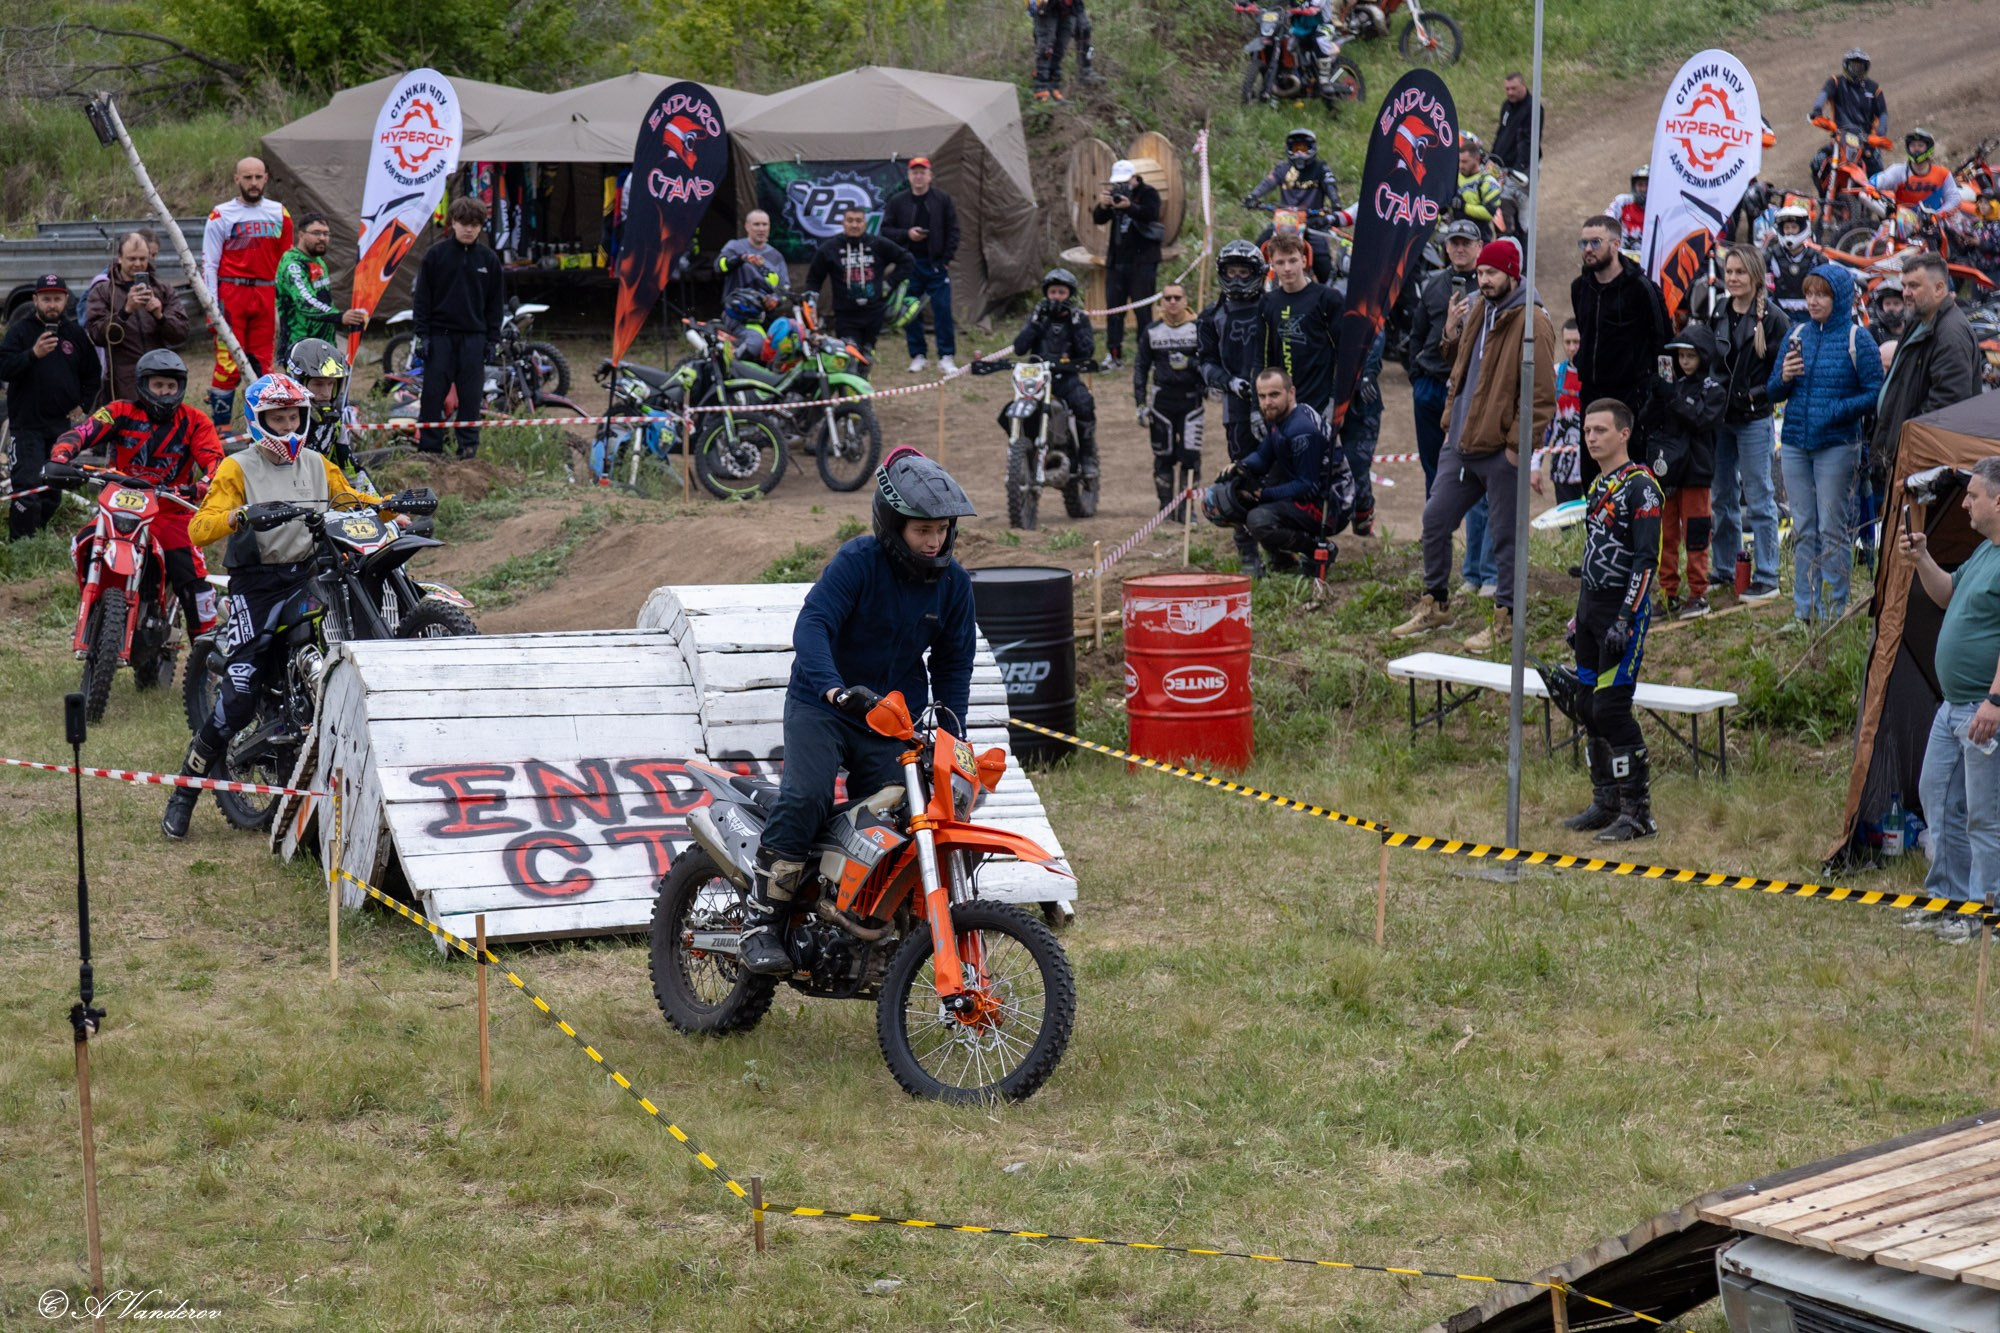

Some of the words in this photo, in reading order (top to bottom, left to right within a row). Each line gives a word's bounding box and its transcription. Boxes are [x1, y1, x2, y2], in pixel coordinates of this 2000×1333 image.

[1676, 64, 1719, 105] СТАНКИ
[1722, 66, 1745, 94] ЧПУ
[391, 83, 426, 119] СТАНКИ
[429, 84, 447, 106] ЧПУ
[648, 93, 721, 137] ENDURO
[1380, 87, 1453, 147] ENDURO
[380, 130, 453, 148] HYPERCUT
[1665, 119, 1754, 145] HYPERCUT
[414, 159, 446, 187] МЕТАЛЛА
[1708, 157, 1745, 189] МЕТАЛЛА
[124, 496, 137, 506] 17
[876, 467, 902, 509] 100%
[353, 525, 368, 534] 14
[1165, 676, 1225, 691] SINTEC
[711, 937, 738, 948] ZUUM
